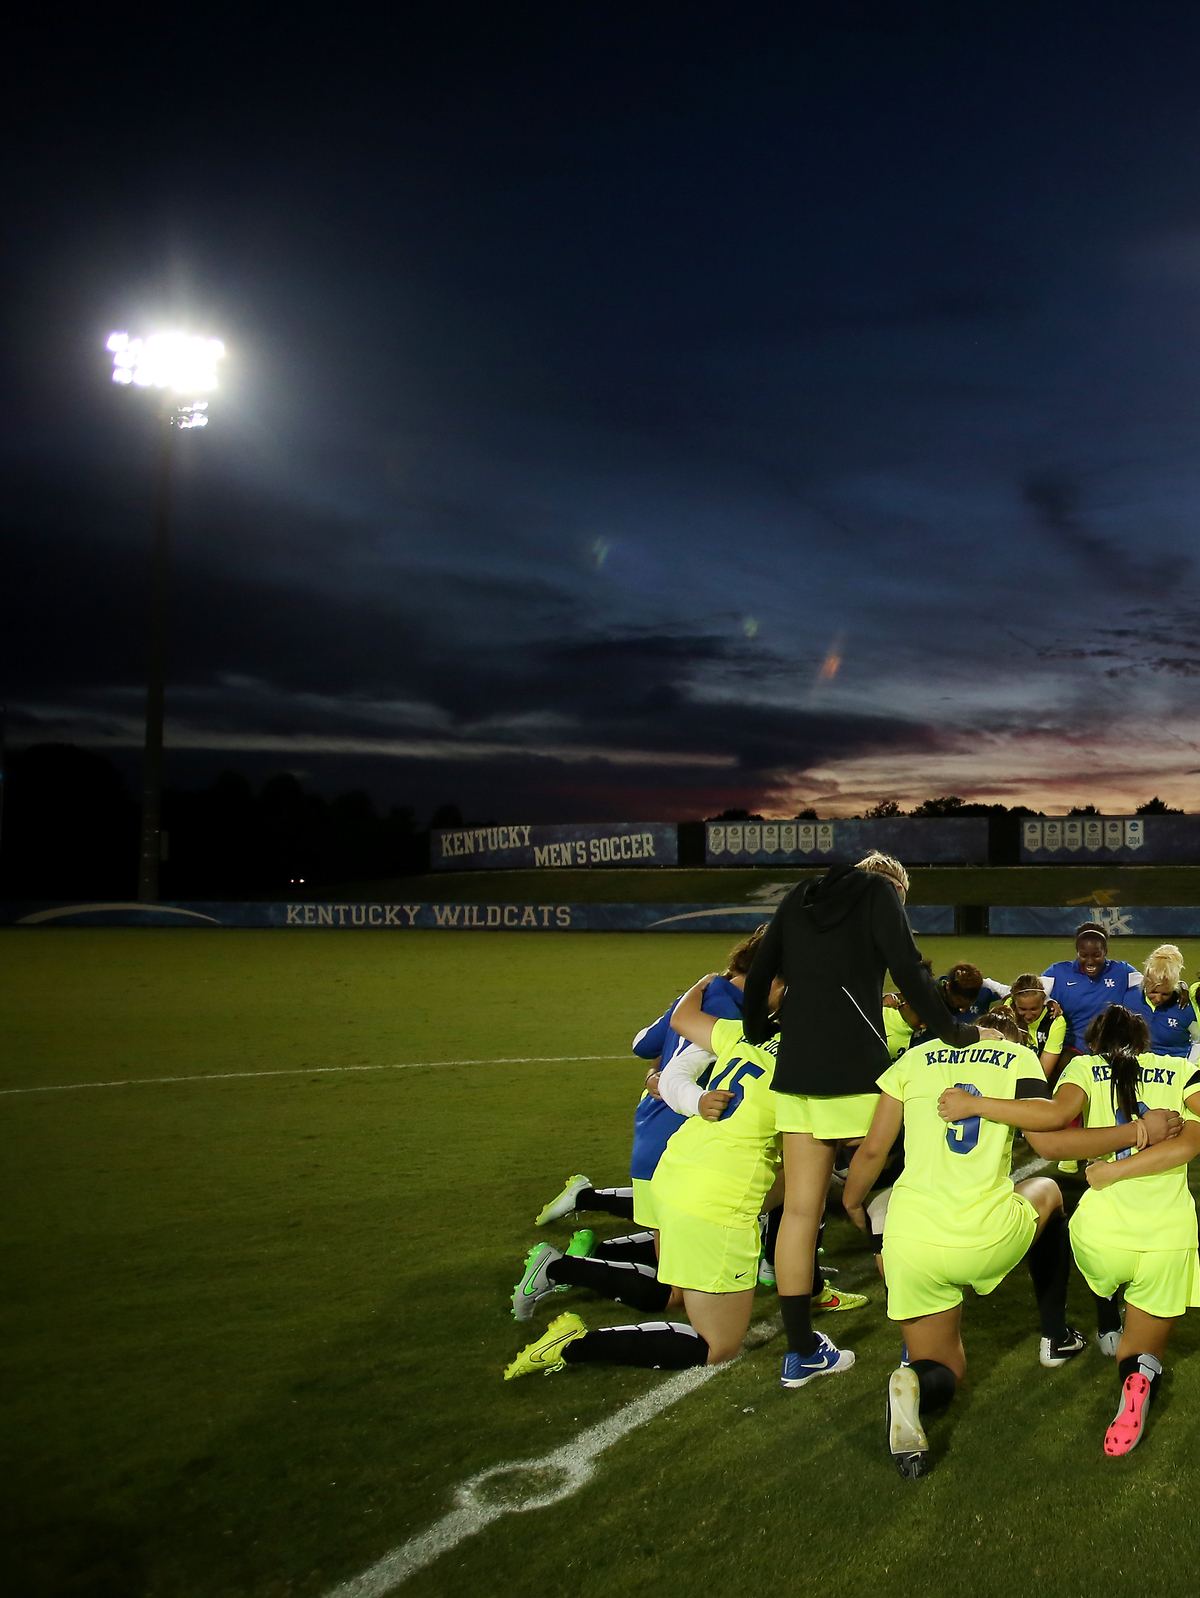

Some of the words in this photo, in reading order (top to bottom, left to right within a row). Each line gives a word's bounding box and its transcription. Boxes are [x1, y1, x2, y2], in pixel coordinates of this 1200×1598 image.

[441, 825, 531, 857] KENTUCKY
[533, 840, 586, 867] MEN'S
[590, 833, 655, 863] SOCCER
[286, 904, 421, 926] KENTUCKY
[432, 905, 571, 927] WILDCATS
[924, 1048, 1017, 1069] KENTUCKY
[1092, 1065, 1176, 1086] KECKY
[708, 1057, 766, 1122] 15
